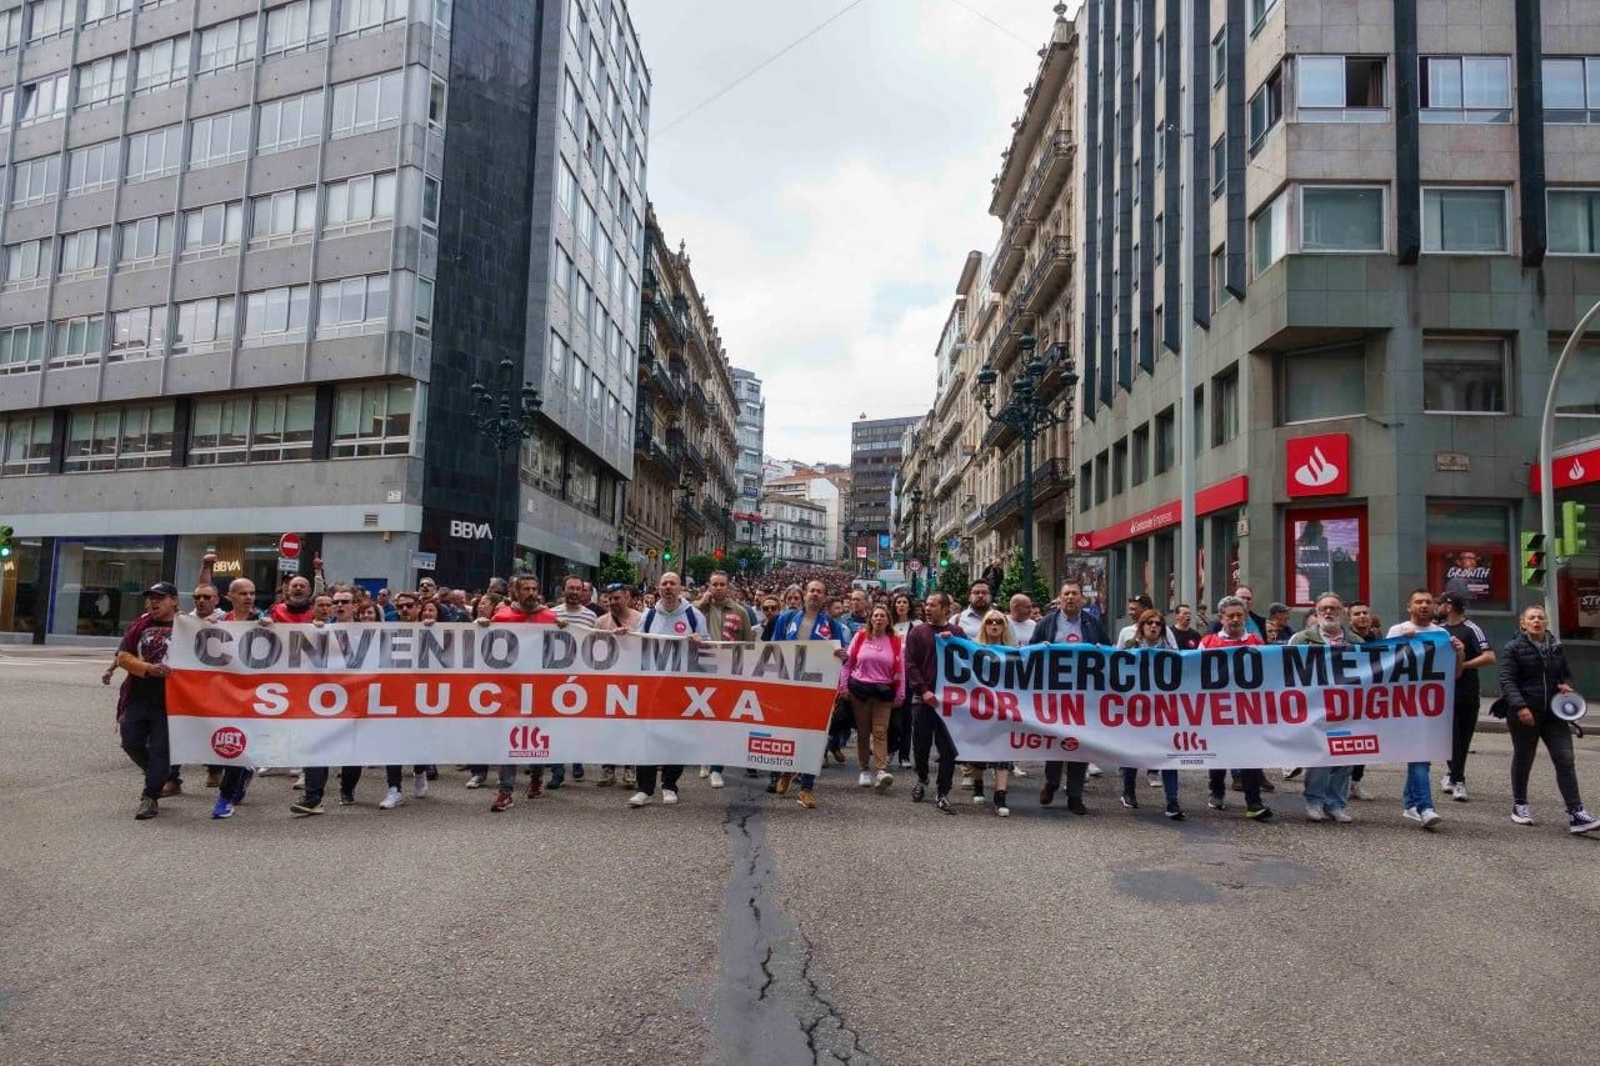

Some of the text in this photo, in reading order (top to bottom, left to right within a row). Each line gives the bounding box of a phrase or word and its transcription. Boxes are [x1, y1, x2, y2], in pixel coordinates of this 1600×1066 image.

[450, 519, 493, 540] BBVA
[213, 560, 241, 572] BBVA
[1447, 566, 1490, 578] GROWTH
[194, 626, 823, 683] CONVENIO DO METAL
[944, 640, 1446, 692] COMERCIO DO METAL
[252, 675, 638, 717] SOLUCIÓN
[942, 683, 1446, 728] POR UN CONVENIO DIGNO
[215, 731, 242, 746] UGT
[509, 725, 550, 749] CIG
[751, 739, 792, 754] CCOO
[1009, 731, 1057, 750] UGT
[1173, 731, 1208, 751] CIG
[1331, 738, 1377, 754] CCOO
[747, 754, 793, 767] industria
